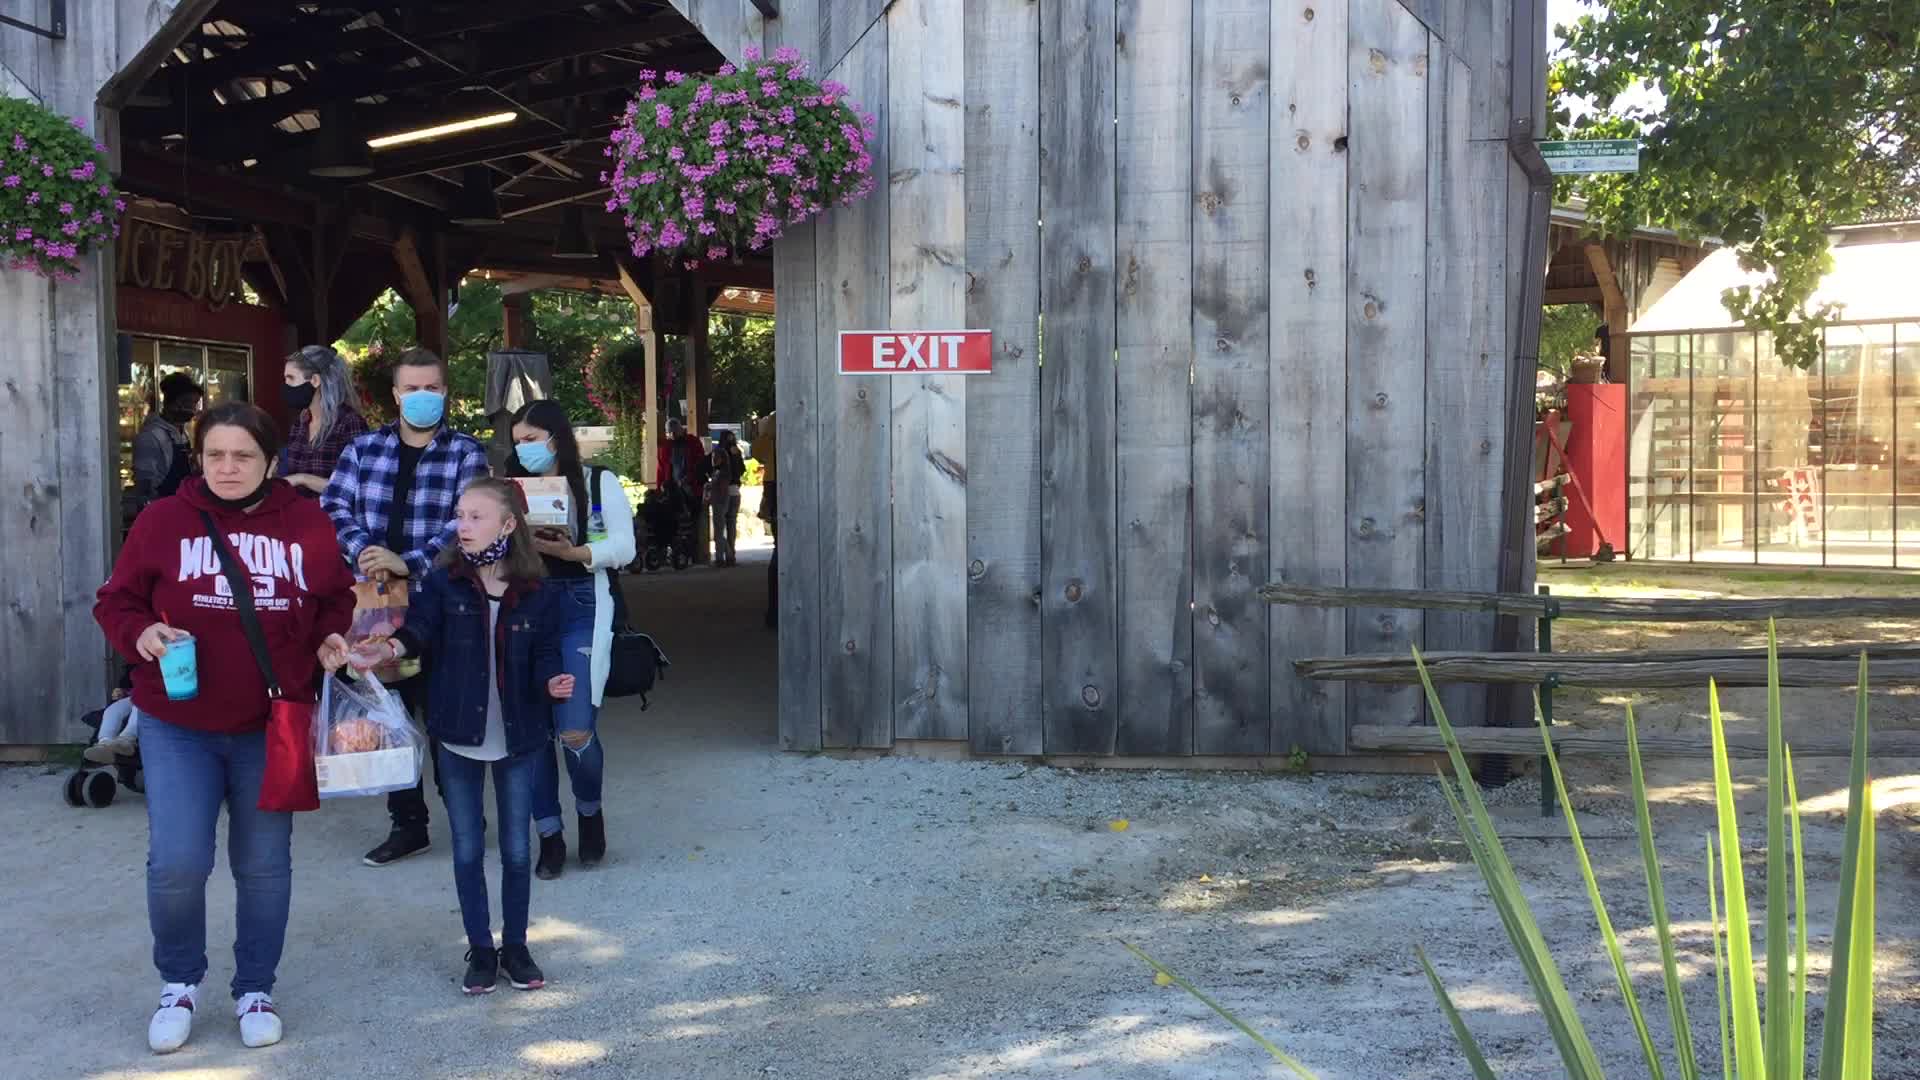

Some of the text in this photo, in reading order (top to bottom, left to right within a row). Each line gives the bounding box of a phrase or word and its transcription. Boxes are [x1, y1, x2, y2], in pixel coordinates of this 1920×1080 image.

[118, 222, 184, 289] ICE
[872, 336, 966, 369] EXIT
[192, 594, 228, 606] ATHLETICS
